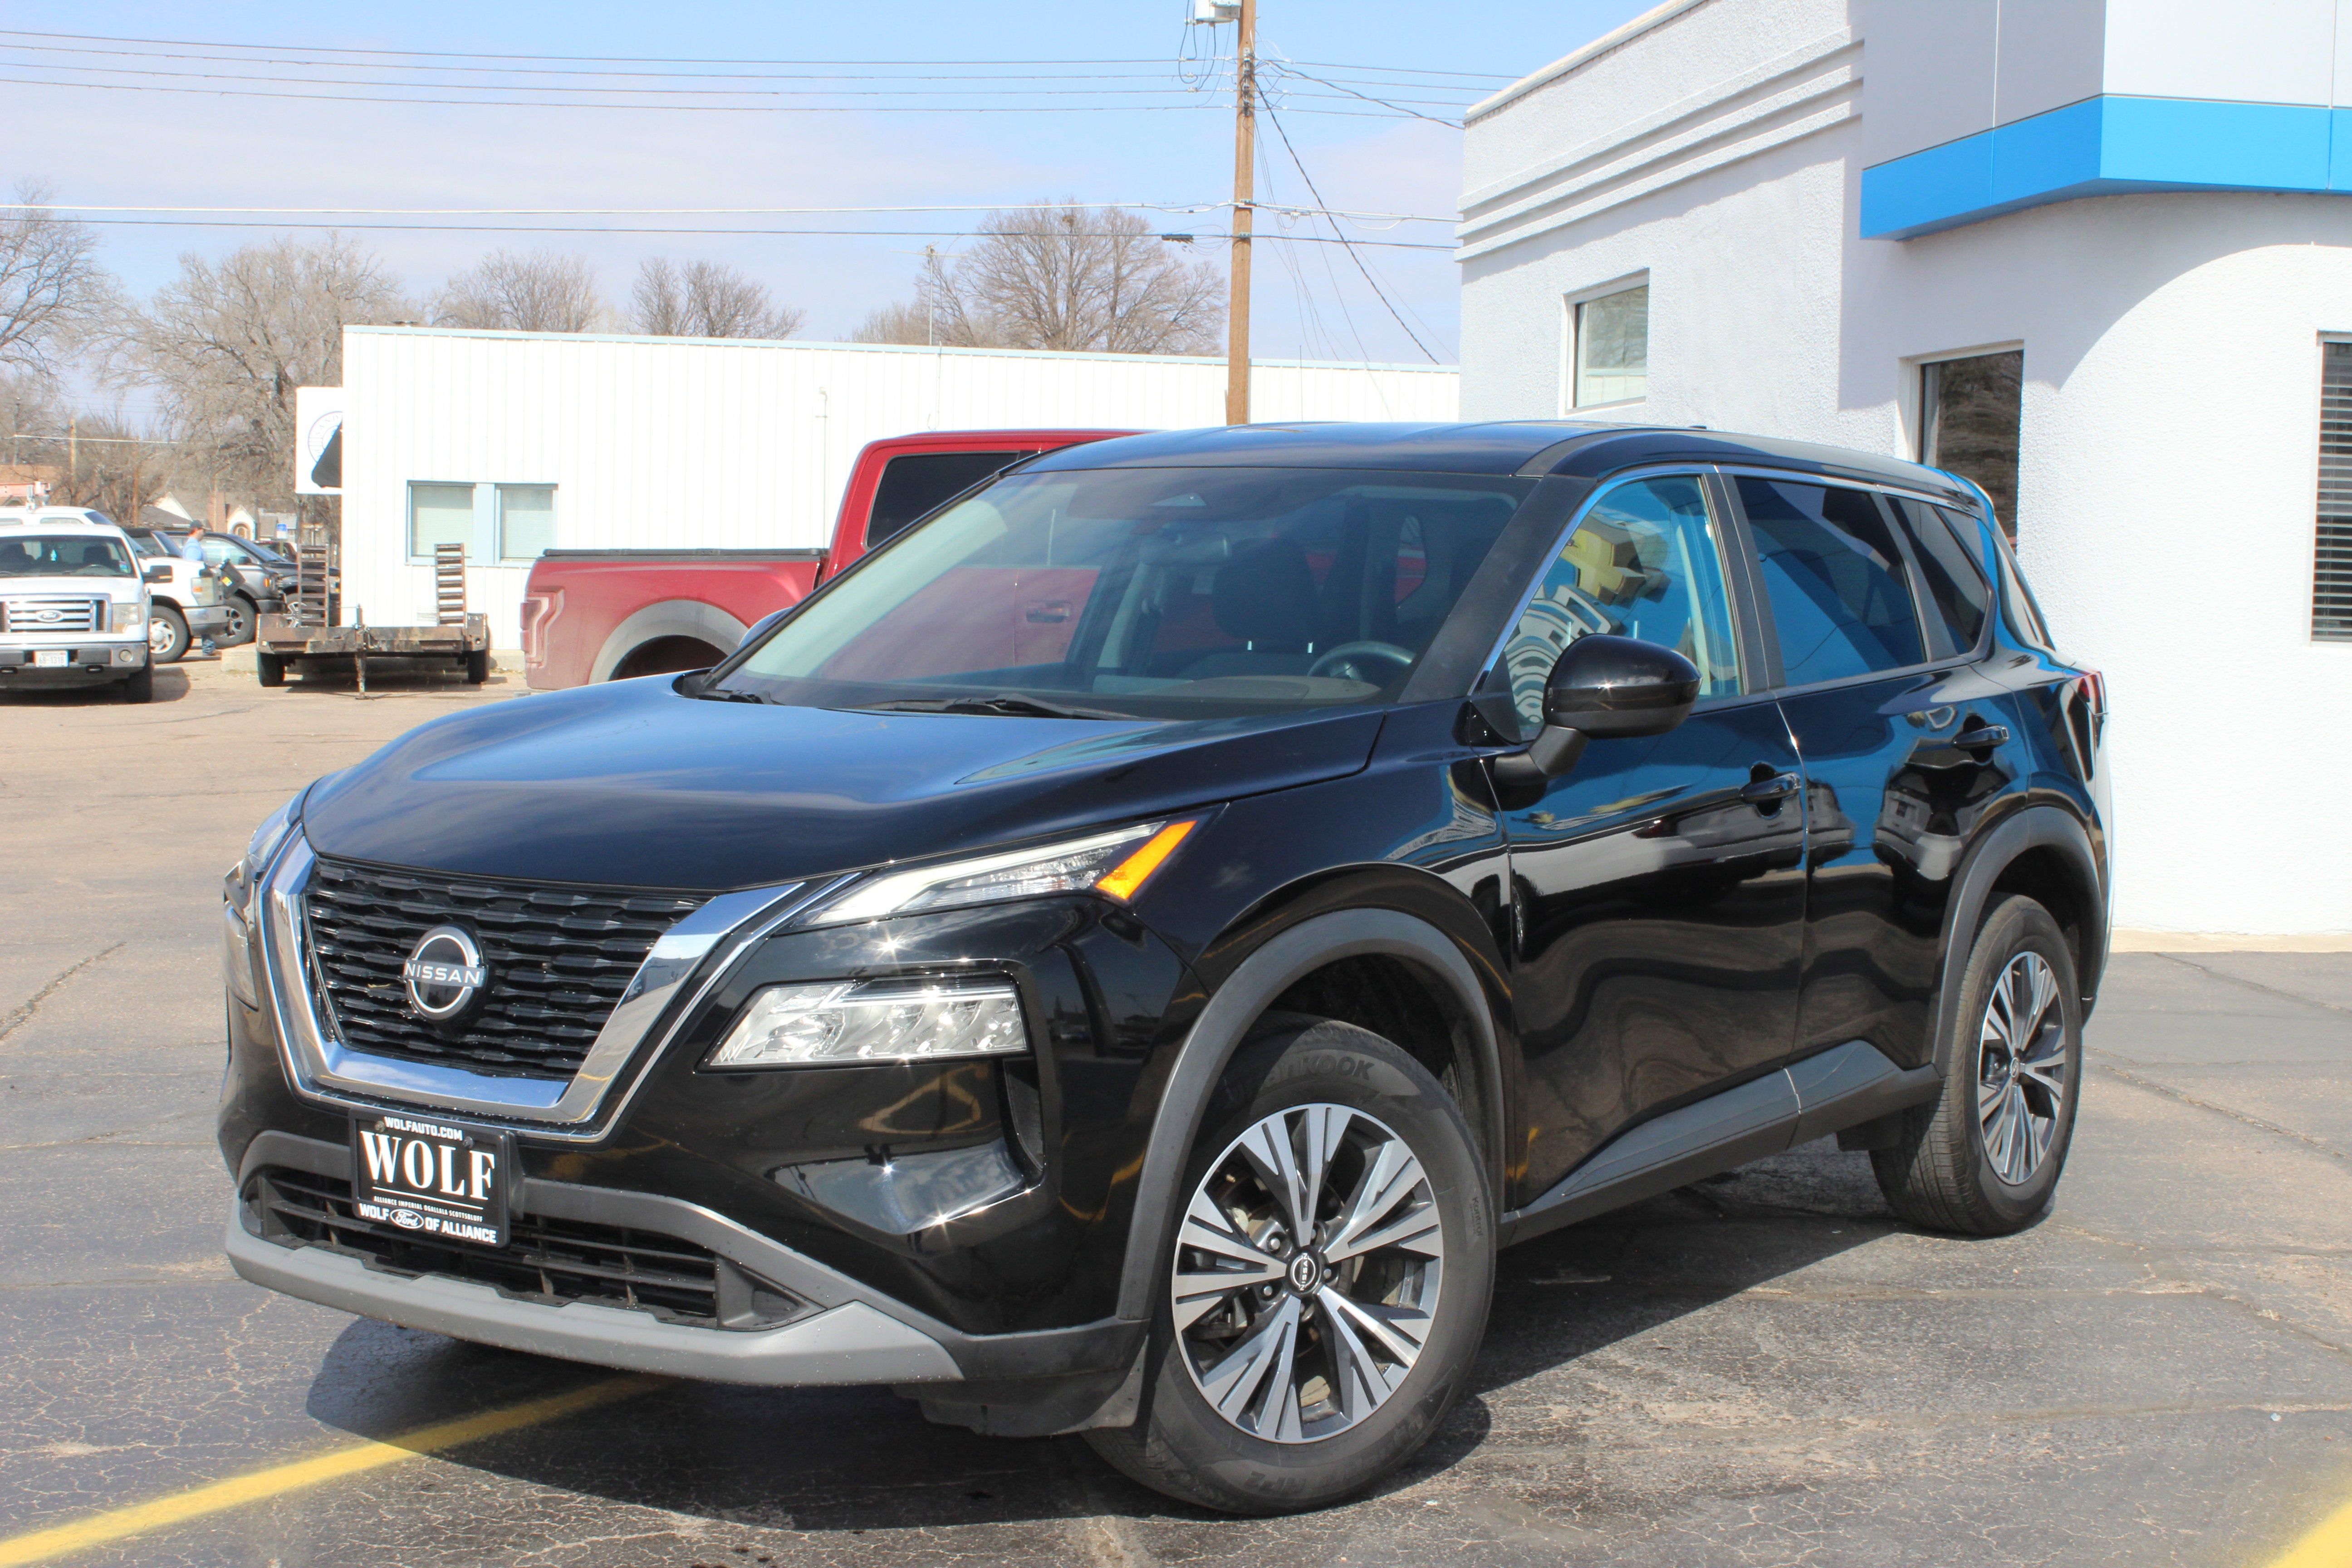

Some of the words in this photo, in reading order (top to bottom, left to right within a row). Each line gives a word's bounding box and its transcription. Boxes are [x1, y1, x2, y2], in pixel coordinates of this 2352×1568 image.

[405, 963, 480, 984] NISSAN
[384, 1116, 464, 1141] WOLFAUTO.COM
[360, 1130, 495, 1200] WOLF
[358, 1203, 389, 1221] WOLF
[395, 1210, 419, 1226] Ford
[425, 1216, 441, 1231] OF
[441, 1220, 497, 1244] ALLIANCE
[373, 1196, 397, 1206] ALLIANCE
[398, 1200, 423, 1210] IMPERIAL
[424, 1205, 448, 1216] OGALLALA
[449, 1210, 483, 1222] SCOTTSBLUFF
[1300, 1253, 1308, 1291] NISSAN
